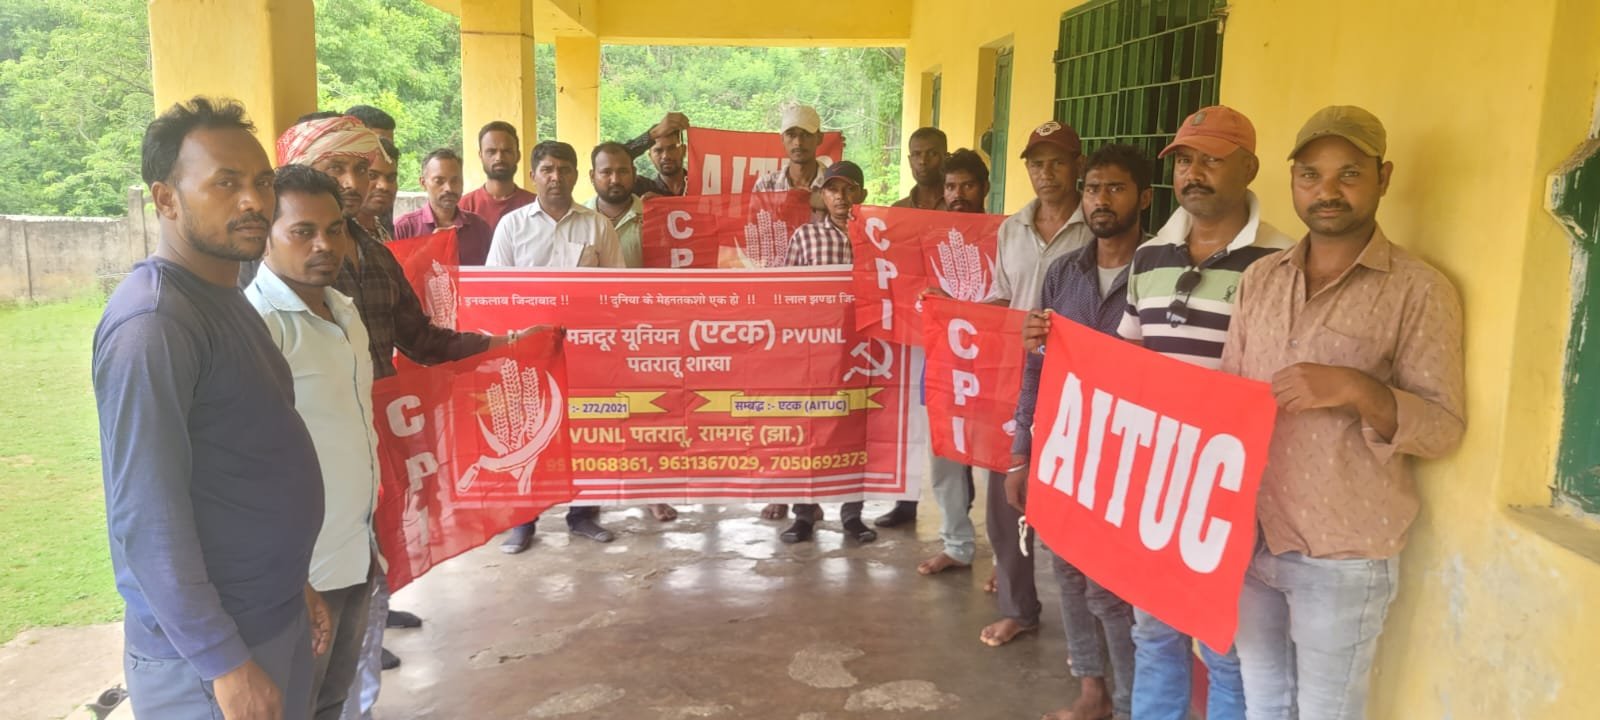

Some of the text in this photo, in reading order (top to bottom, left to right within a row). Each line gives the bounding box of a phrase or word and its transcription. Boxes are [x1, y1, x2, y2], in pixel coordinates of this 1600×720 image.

[700, 153, 834, 217] AIT
[865, 217, 898, 330] CPI
[610, 293, 640, 308] दुनिया
[642, 293, 654, 305] के
[709, 295, 727, 307] एक
[784, 295, 807, 305] लाल
[567, 320, 846, 351] मजदूर यूनियन (एटक) PVUNL
[626, 356, 732, 378] पतरातू शाखा
[948, 319, 979, 454] CPI
[582, 403, 628, 414] 272/2021
[778, 400, 802, 410] एटक
[804, 400, 847, 413] (AITUC)
[555, 424, 804, 447] VUNL पतरातू, रामगढ़ (झा.)
[658, 455, 764, 472] 9631367029,
[770, 451, 868, 470] 7050692373
[1037, 371, 1247, 574] AITUC
